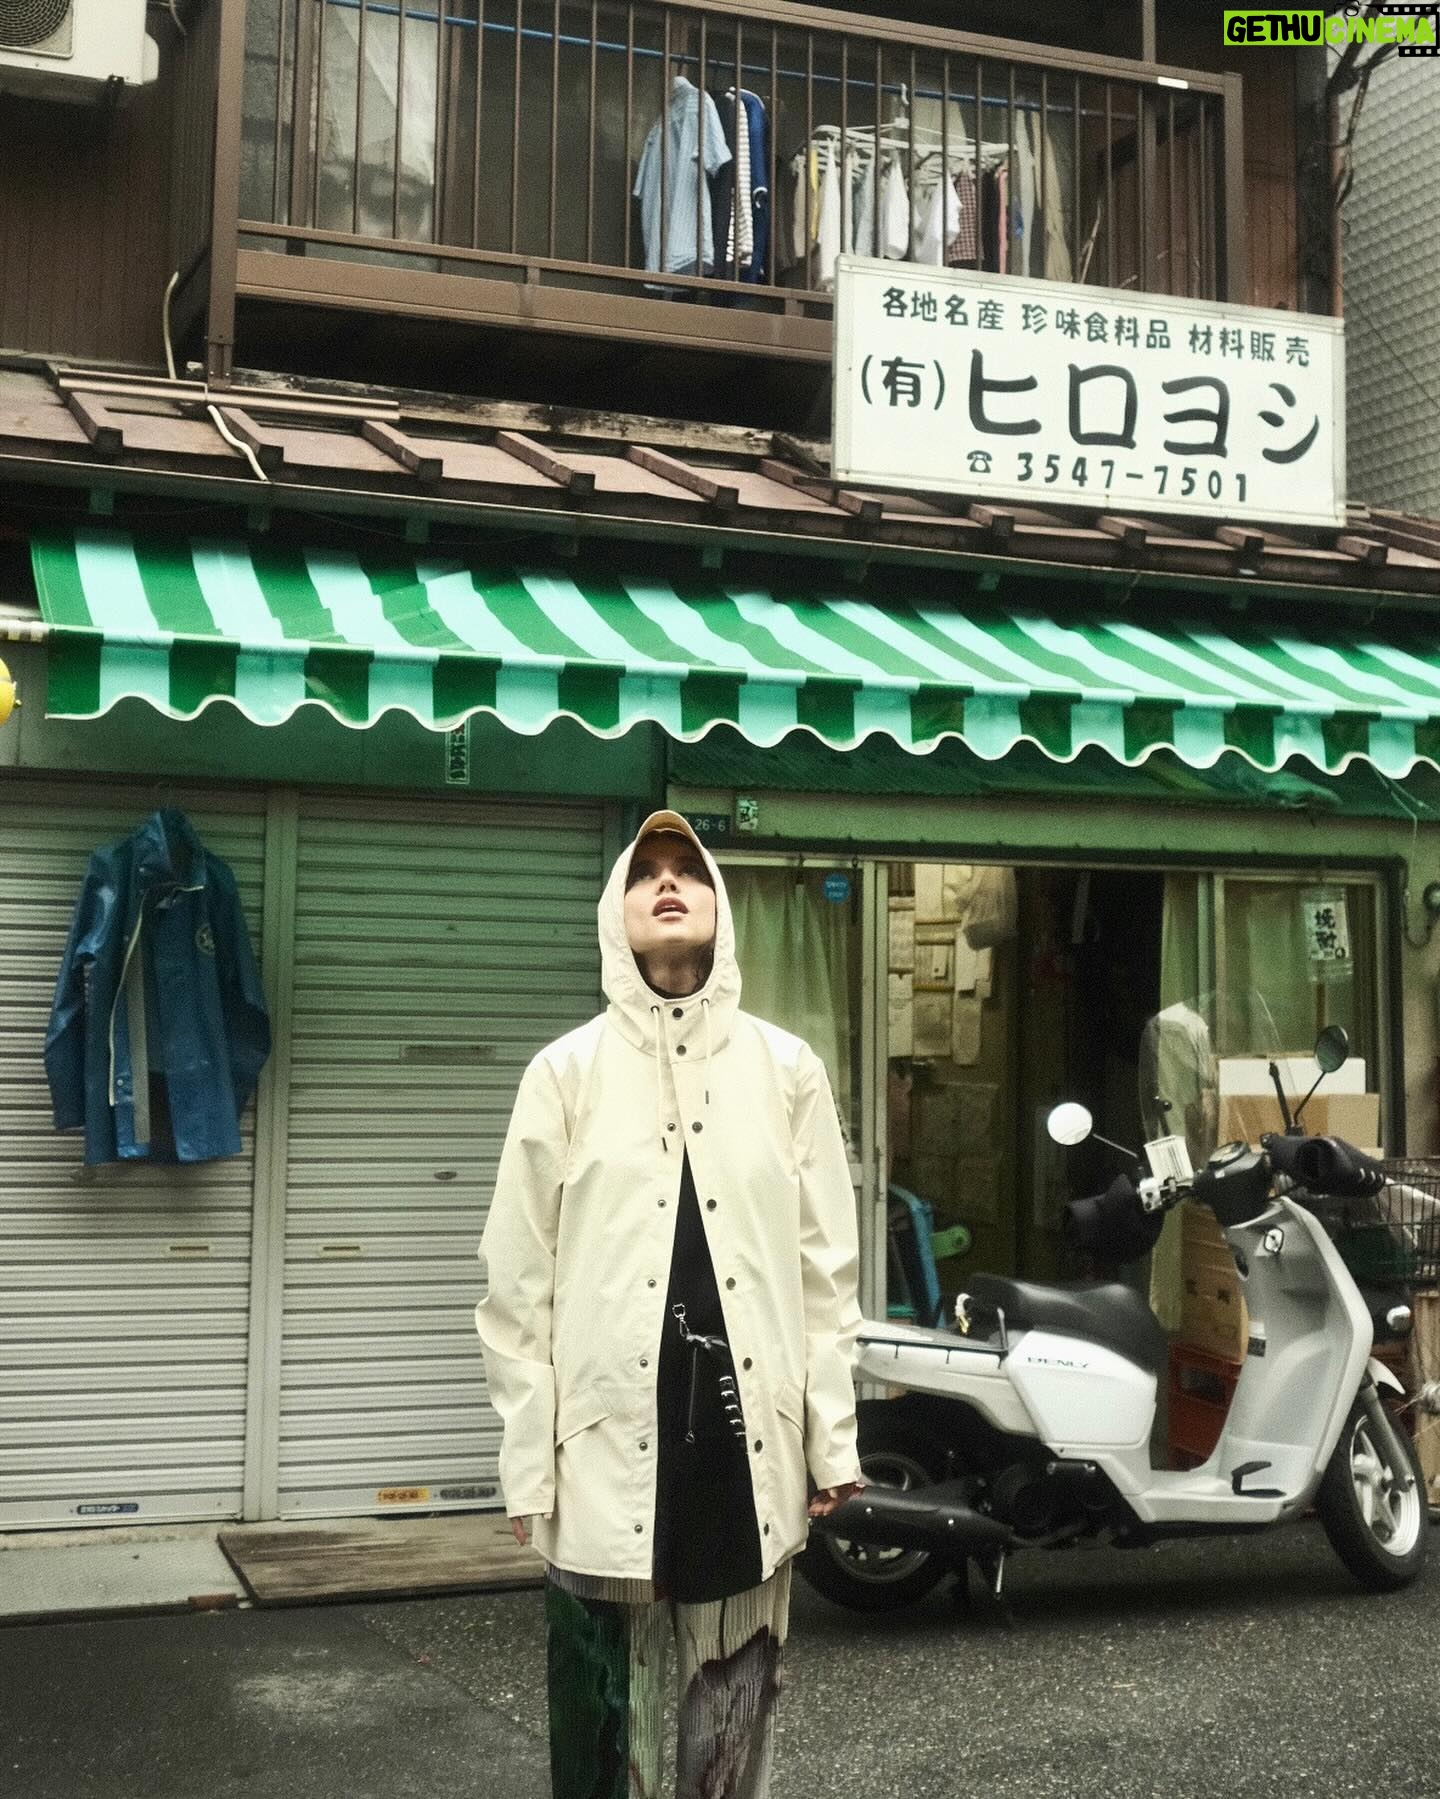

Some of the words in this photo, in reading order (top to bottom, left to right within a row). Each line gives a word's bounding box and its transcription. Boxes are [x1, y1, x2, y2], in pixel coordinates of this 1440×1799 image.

[882, 286, 1005, 331] 各地名産
[1021, 303, 1172, 350] 珍味食料品
[1188, 324, 1309, 368] 材料販売
[1017, 452, 1246, 503] 3547-7501
